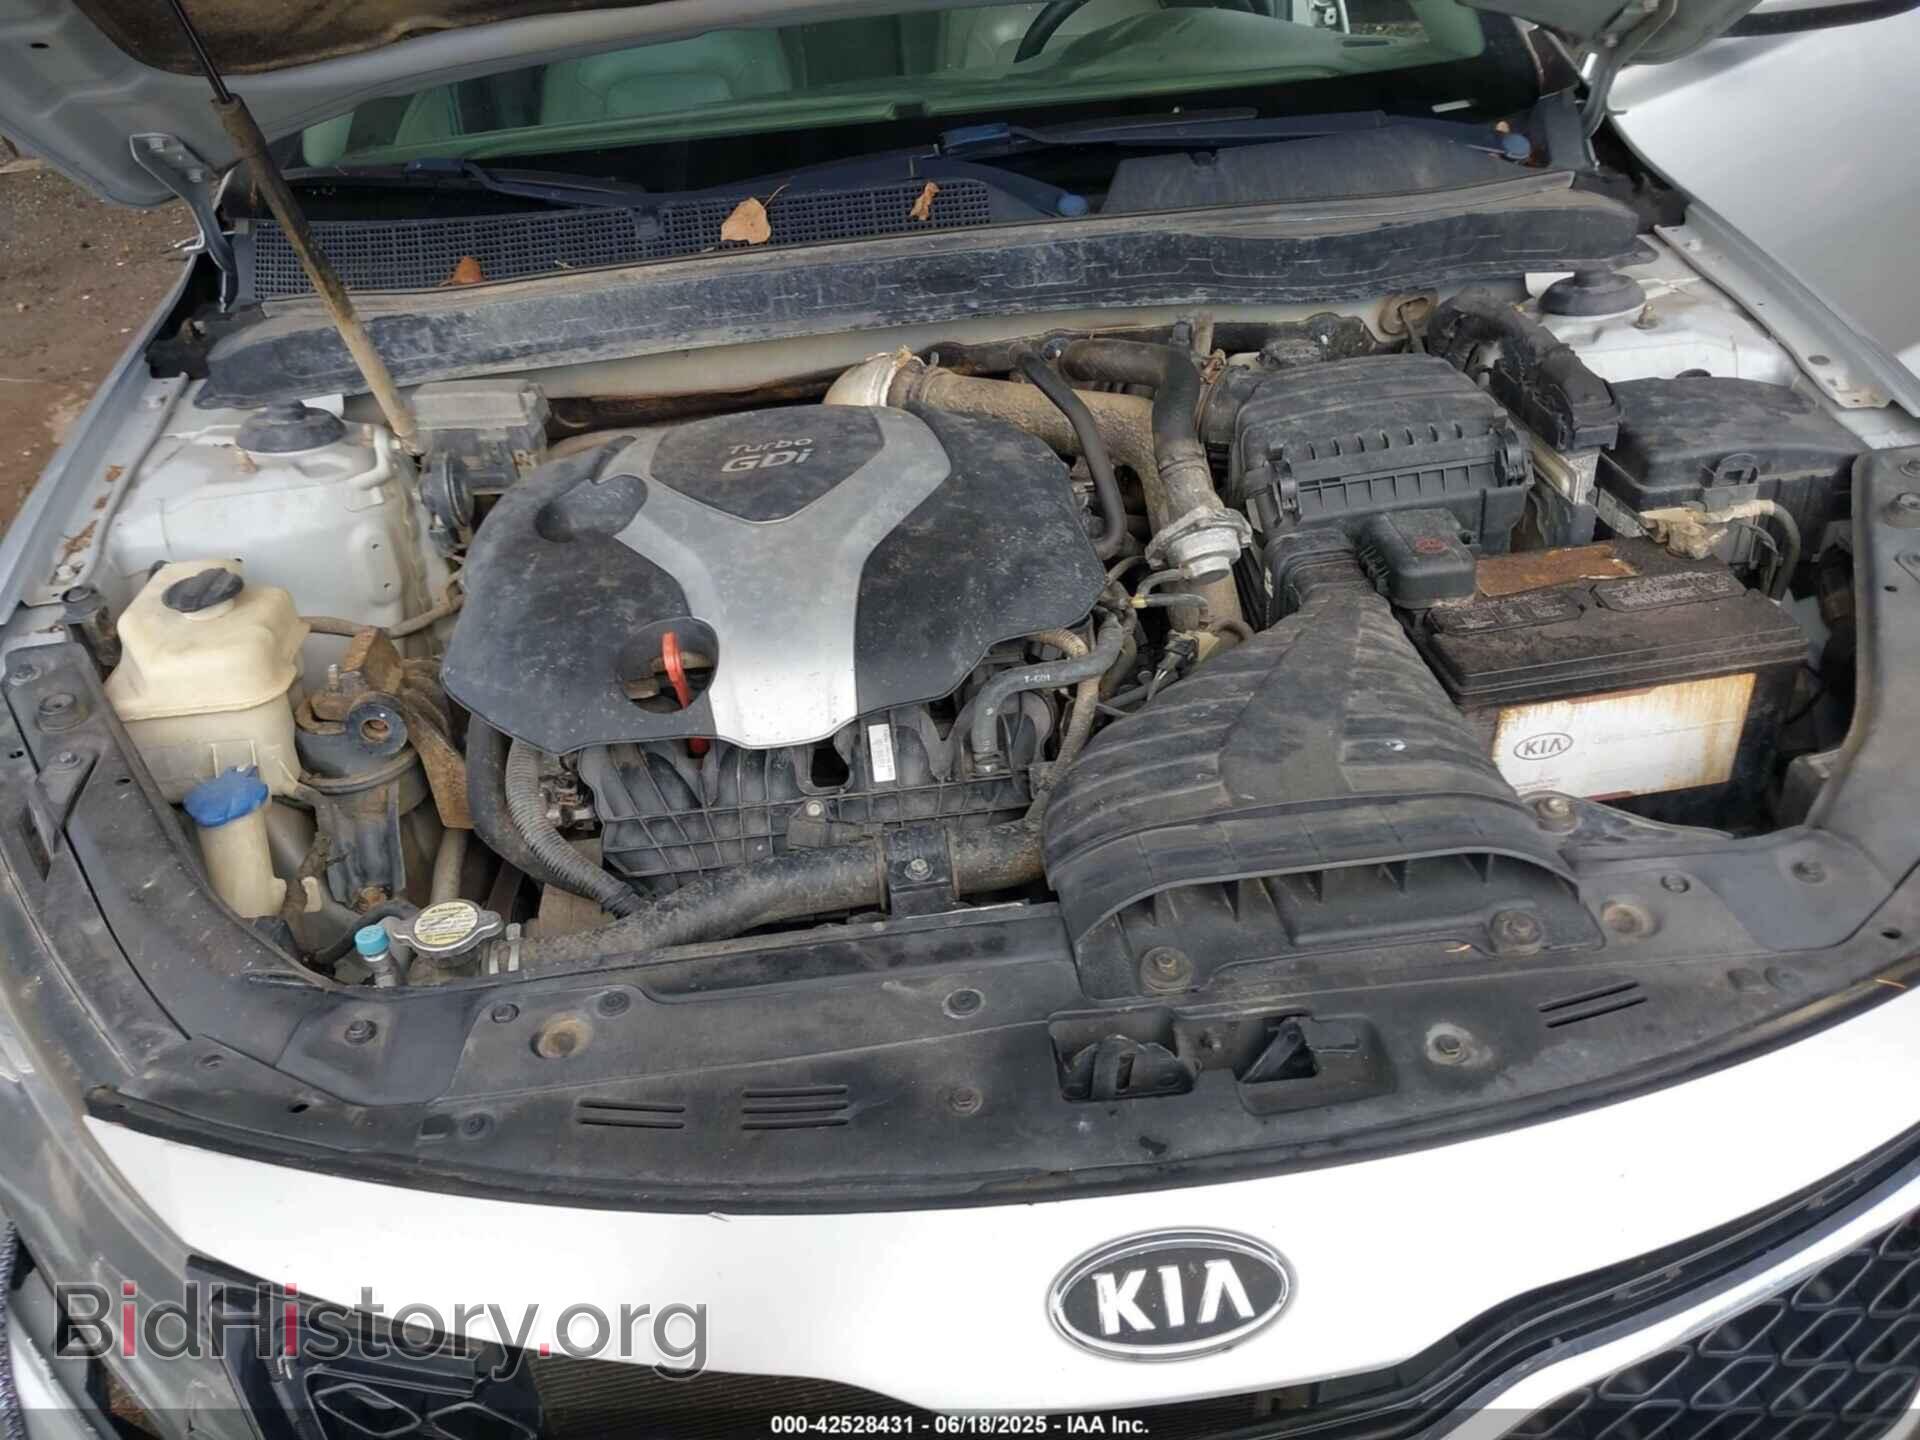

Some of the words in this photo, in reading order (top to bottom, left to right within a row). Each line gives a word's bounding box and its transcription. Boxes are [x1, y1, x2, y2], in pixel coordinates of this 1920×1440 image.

[720, 448, 815, 472] GDi
[1523, 738, 1563, 756] KIA
[1092, 1258, 1256, 1336] KIA
